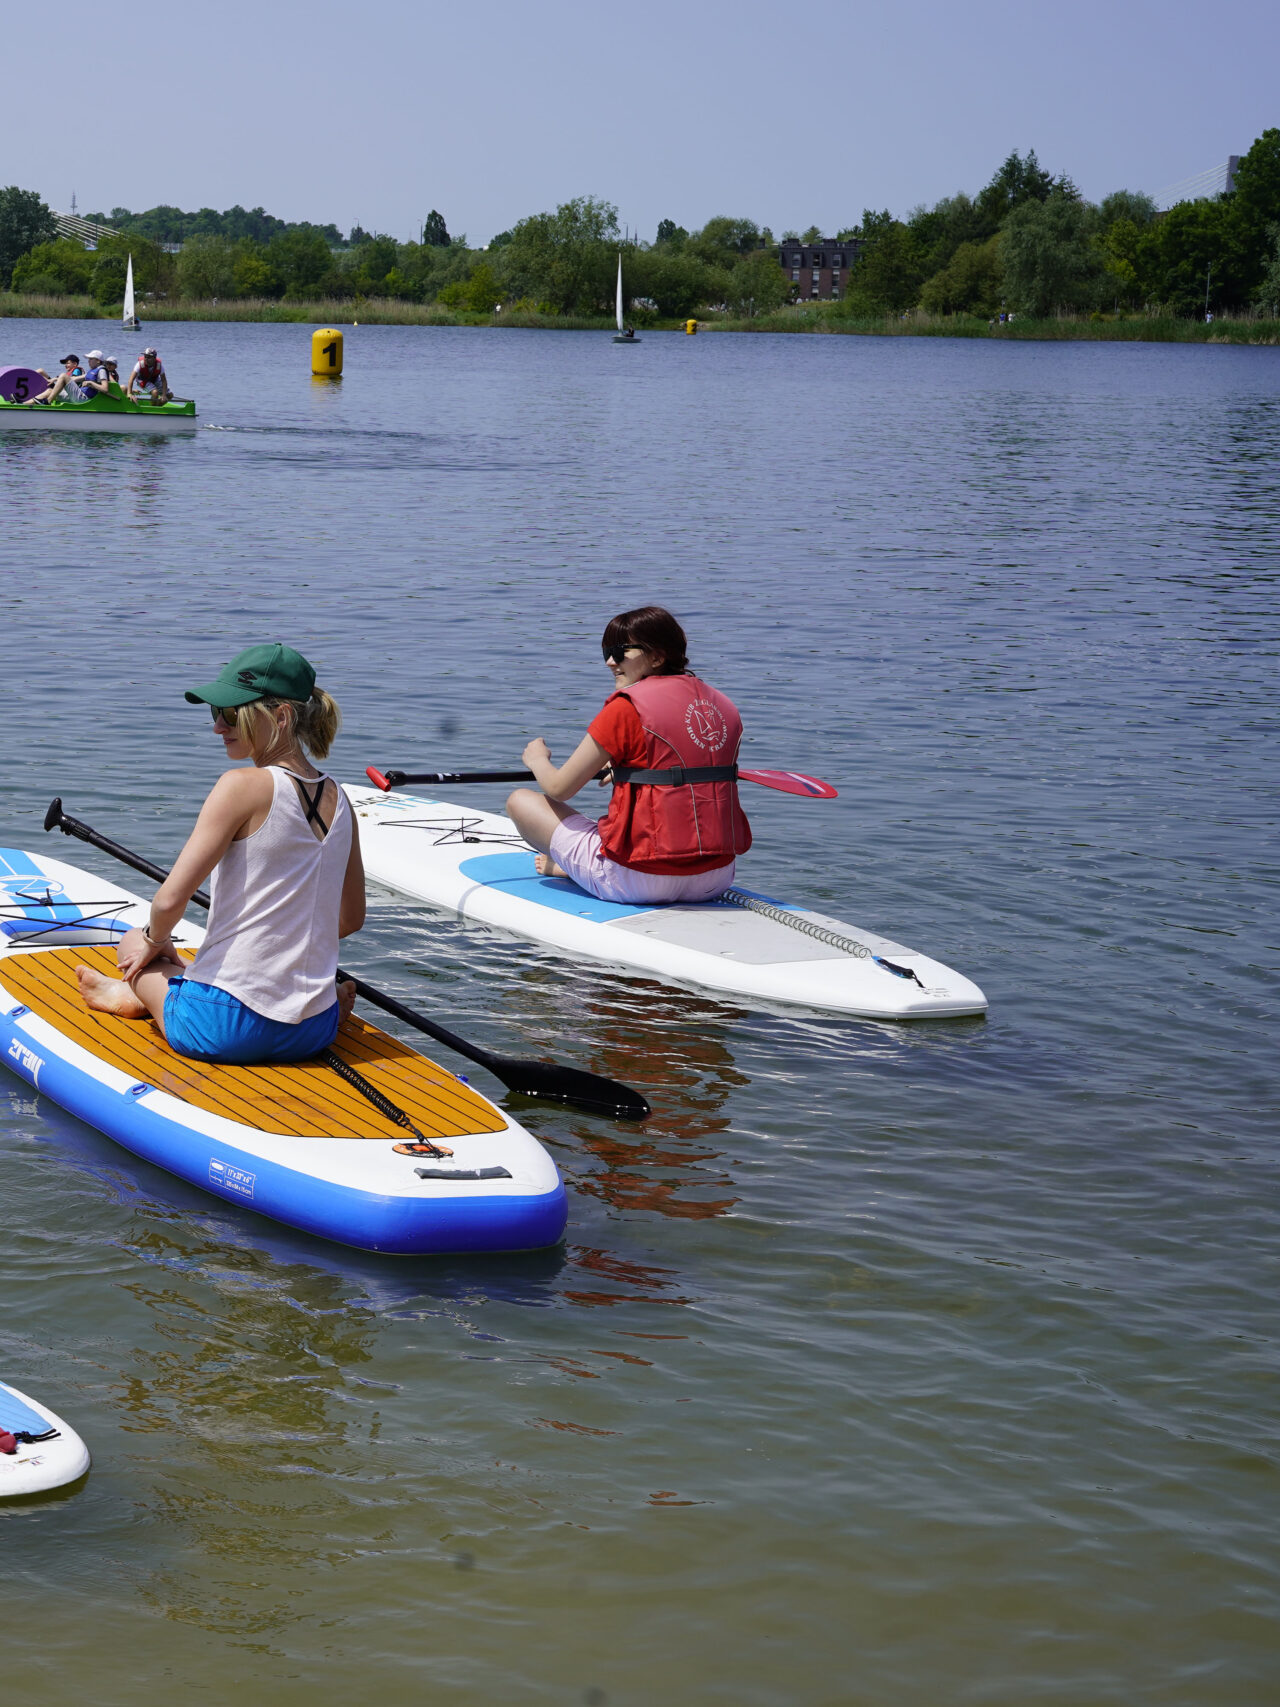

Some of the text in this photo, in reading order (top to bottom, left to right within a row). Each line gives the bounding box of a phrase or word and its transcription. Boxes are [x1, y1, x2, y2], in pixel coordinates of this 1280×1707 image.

[322, 342, 337, 367] 1
[15, 376, 29, 399] 5
[686, 726, 705, 749] HORN
